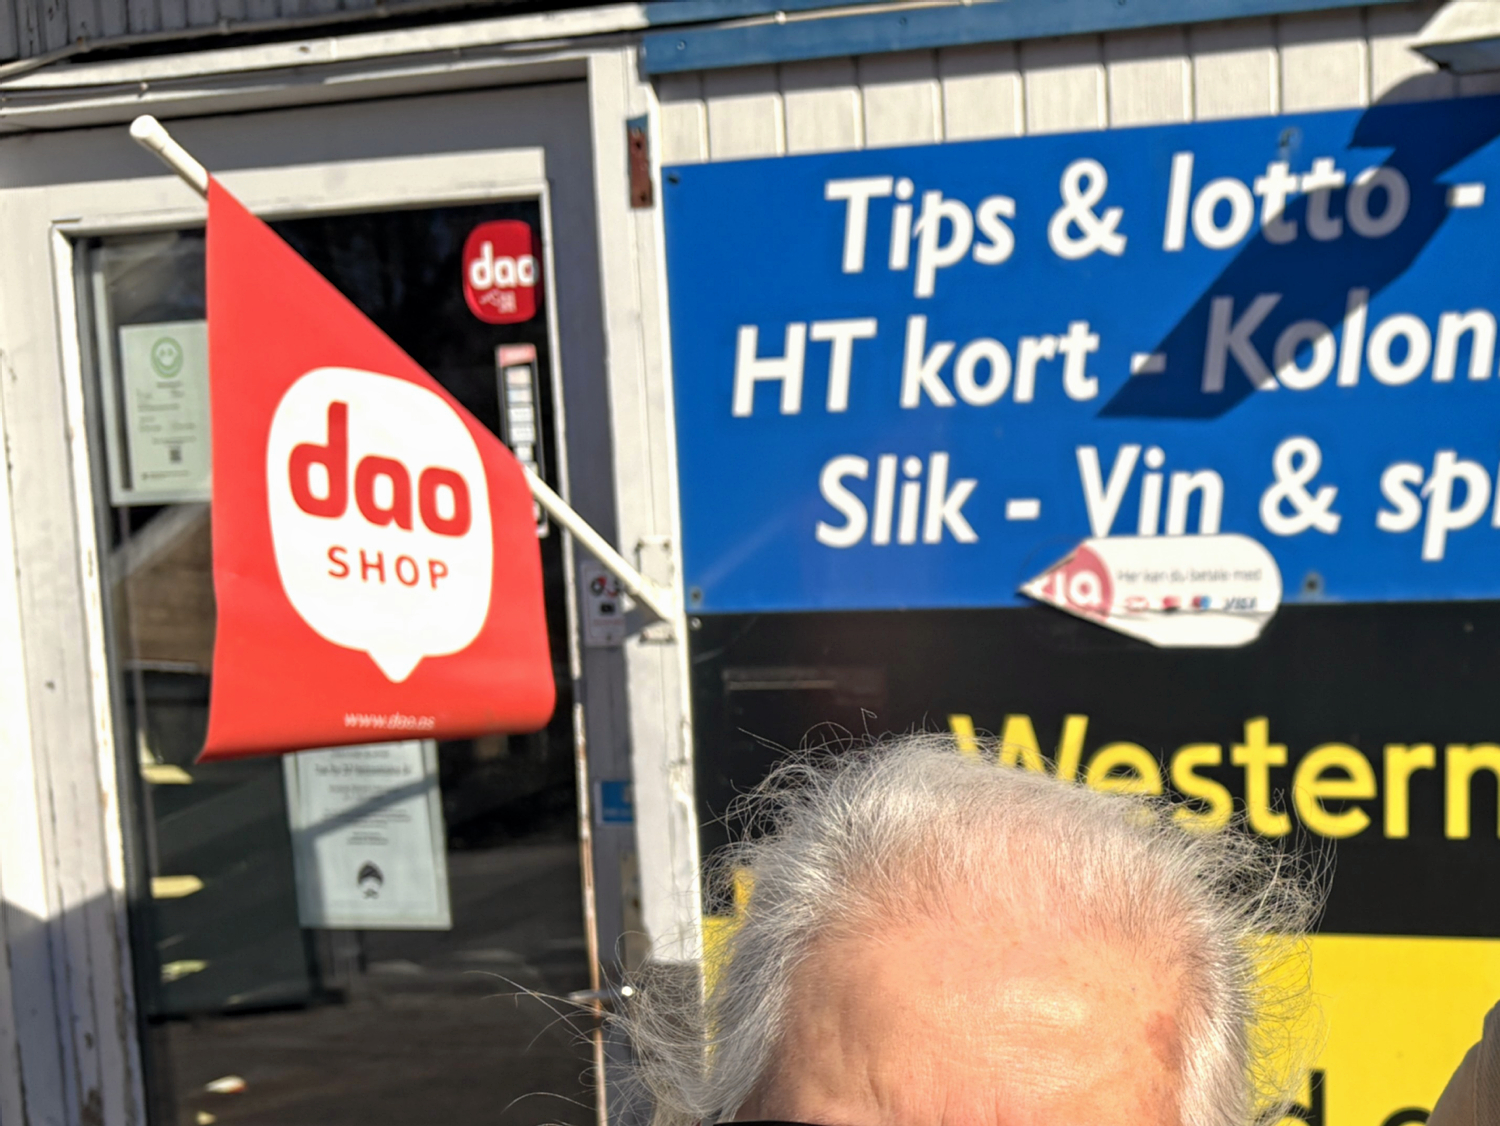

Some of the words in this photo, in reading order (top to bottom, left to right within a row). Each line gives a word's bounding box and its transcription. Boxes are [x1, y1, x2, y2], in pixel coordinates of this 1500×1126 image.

[469, 240, 540, 291] dao
[825, 176, 1015, 298] Tips
[1048, 158, 1128, 260] &
[1164, 152, 1410, 252] lotto
[731, 318, 878, 418] HT
[900, 314, 1101, 410] kort
[289, 402, 470, 537] dao
[815, 452, 978, 549] Slik
[1076, 445, 1224, 537] Vin
[1259, 436, 1342, 537] &
[327, 545, 450, 589] SHOP
